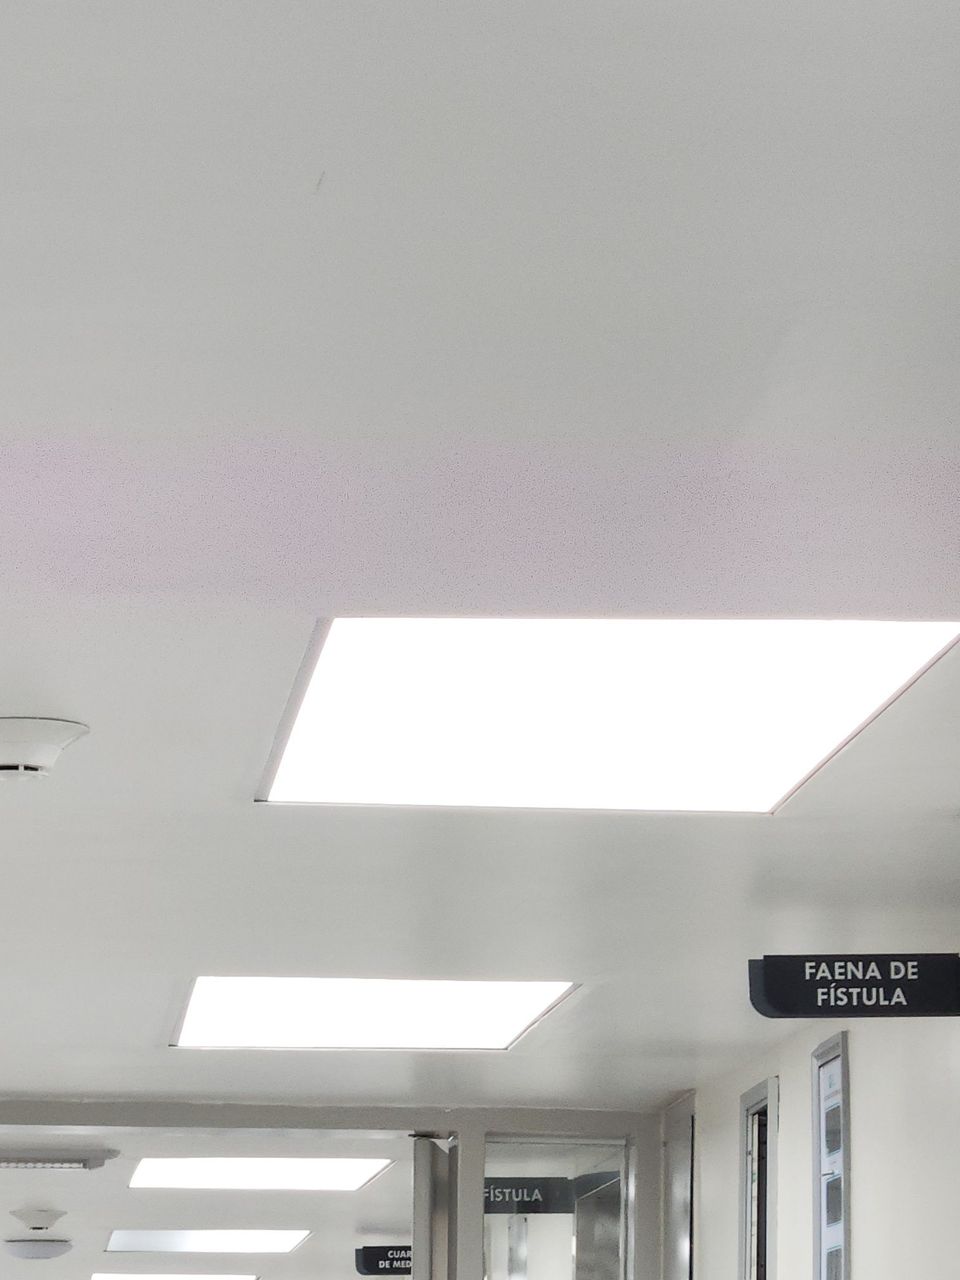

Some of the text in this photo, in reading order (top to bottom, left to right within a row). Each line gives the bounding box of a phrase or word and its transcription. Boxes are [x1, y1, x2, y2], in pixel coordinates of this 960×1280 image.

[804, 961, 919, 980] FAENA DE
[816, 983, 908, 1007] FÍSTULA
[378, 1260, 391, 1268] DE
